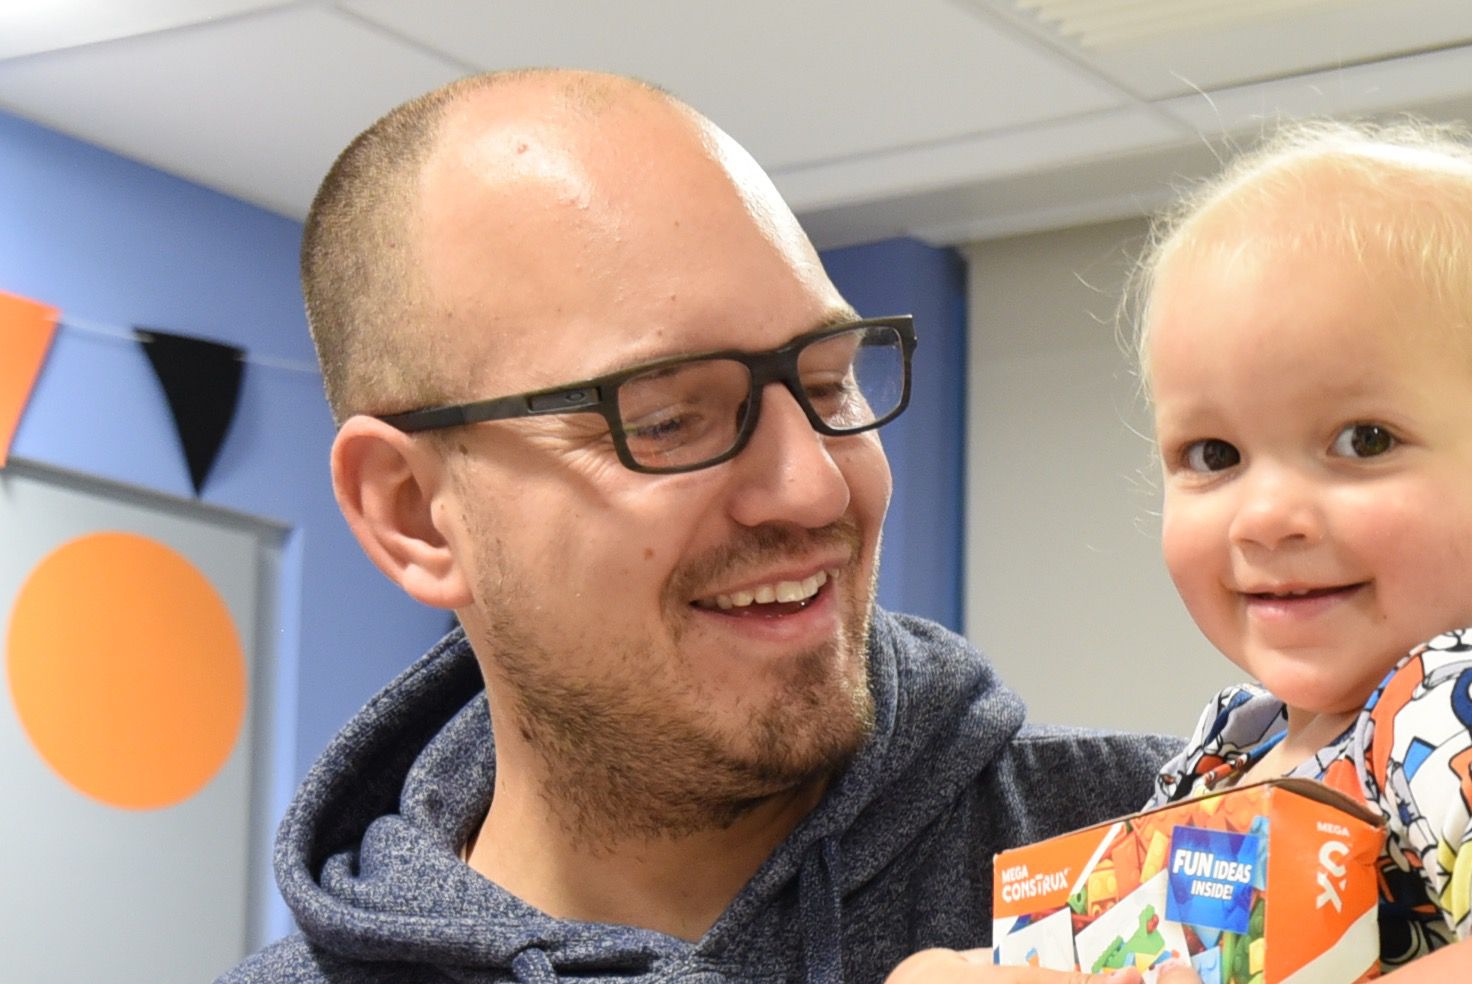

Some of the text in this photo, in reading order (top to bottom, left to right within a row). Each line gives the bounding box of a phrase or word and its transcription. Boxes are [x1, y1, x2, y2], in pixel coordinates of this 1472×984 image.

[1315, 820, 1351, 837] MEGA
[1001, 864, 1029, 884] MEGA
[1172, 848, 1253, 884] FUN IDEAS
[1001, 868, 1069, 903] CONSTRUX
[1190, 879, 1234, 900] INSIDE!
